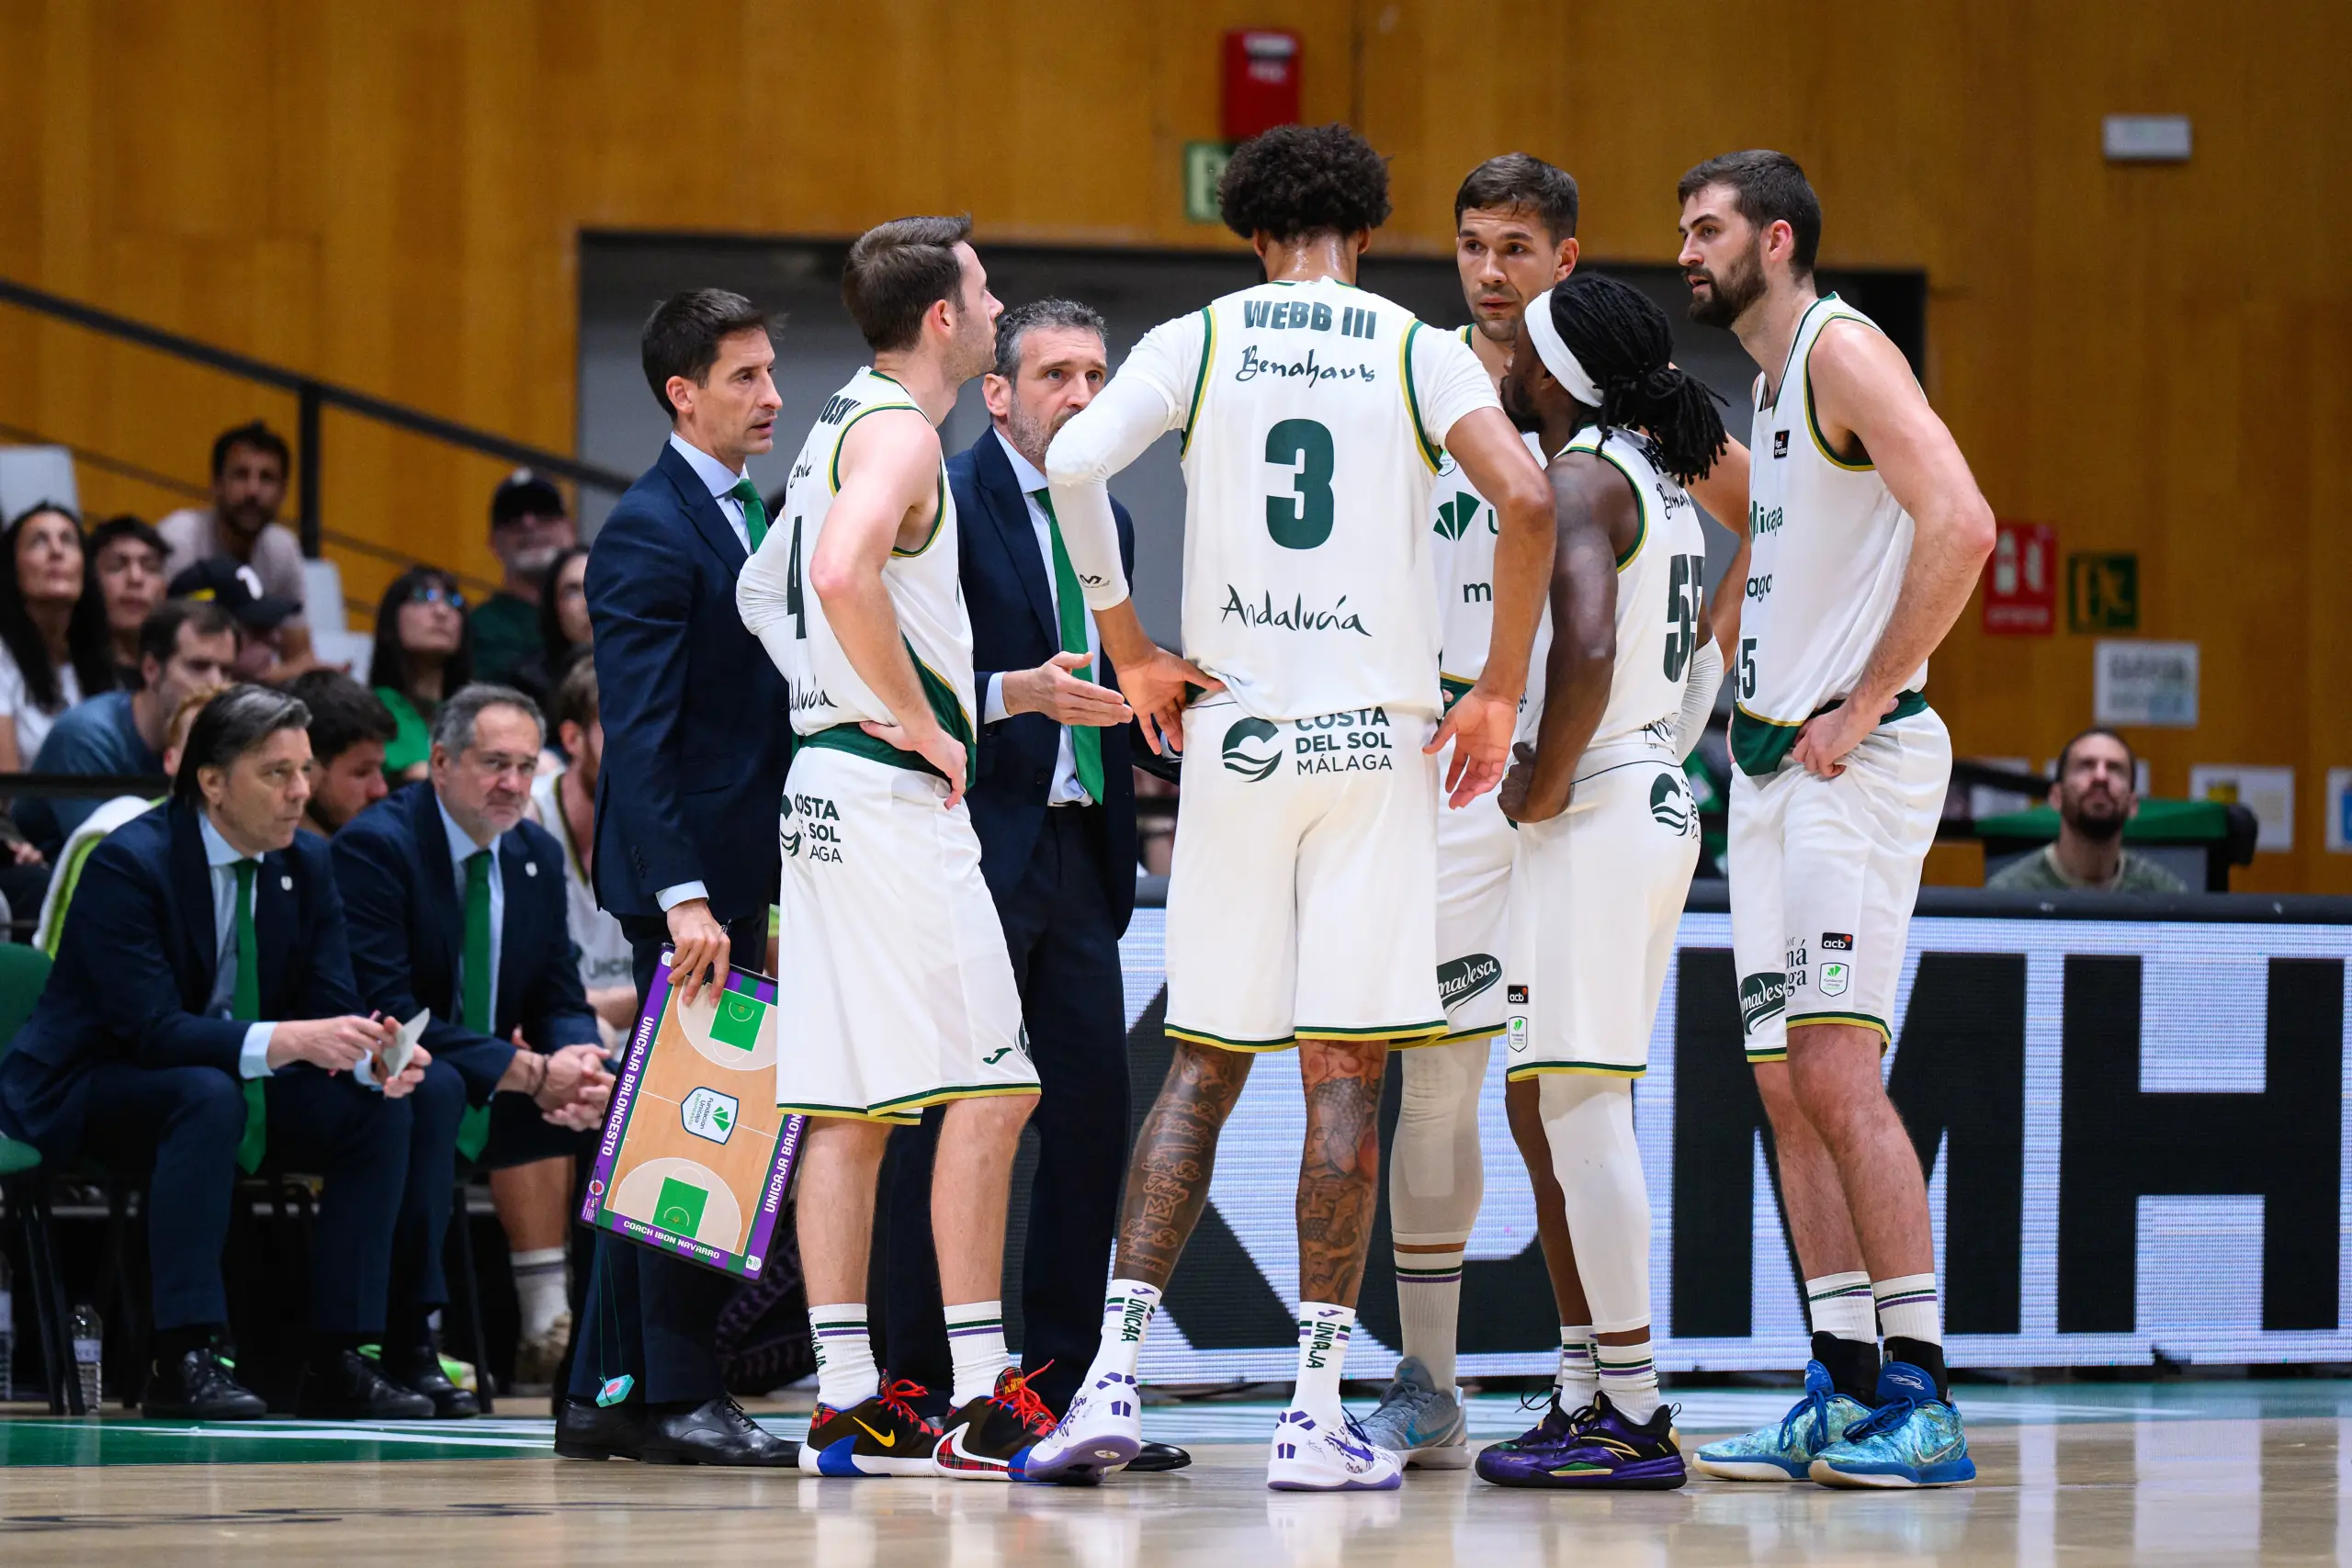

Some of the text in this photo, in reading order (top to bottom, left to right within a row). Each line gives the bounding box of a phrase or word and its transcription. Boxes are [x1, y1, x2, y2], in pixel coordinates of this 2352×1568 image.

[1243, 299, 1377, 340] WEBB III
[1264, 418, 1334, 549] 3
[1220, 583, 1373, 637] Andalucía
[1295, 706, 1390, 732] COSTA
[1295, 731, 1393, 756] DEL SOL
[1296, 751, 1393, 776] MÁLAGA
[808, 822, 842, 843] SOL
[809, 844, 843, 863] AGA
[1823, 939, 1847, 949] acb
[1438, 960, 1498, 996] madesa
[1509, 992, 1525, 1002] acb
[602, 1016, 654, 1157] UNICAJA BALONCESTO
[764, 1113, 803, 1213] UNICAJA BALON
[623, 1220, 720, 1259] COACH IBON NAVARRO
